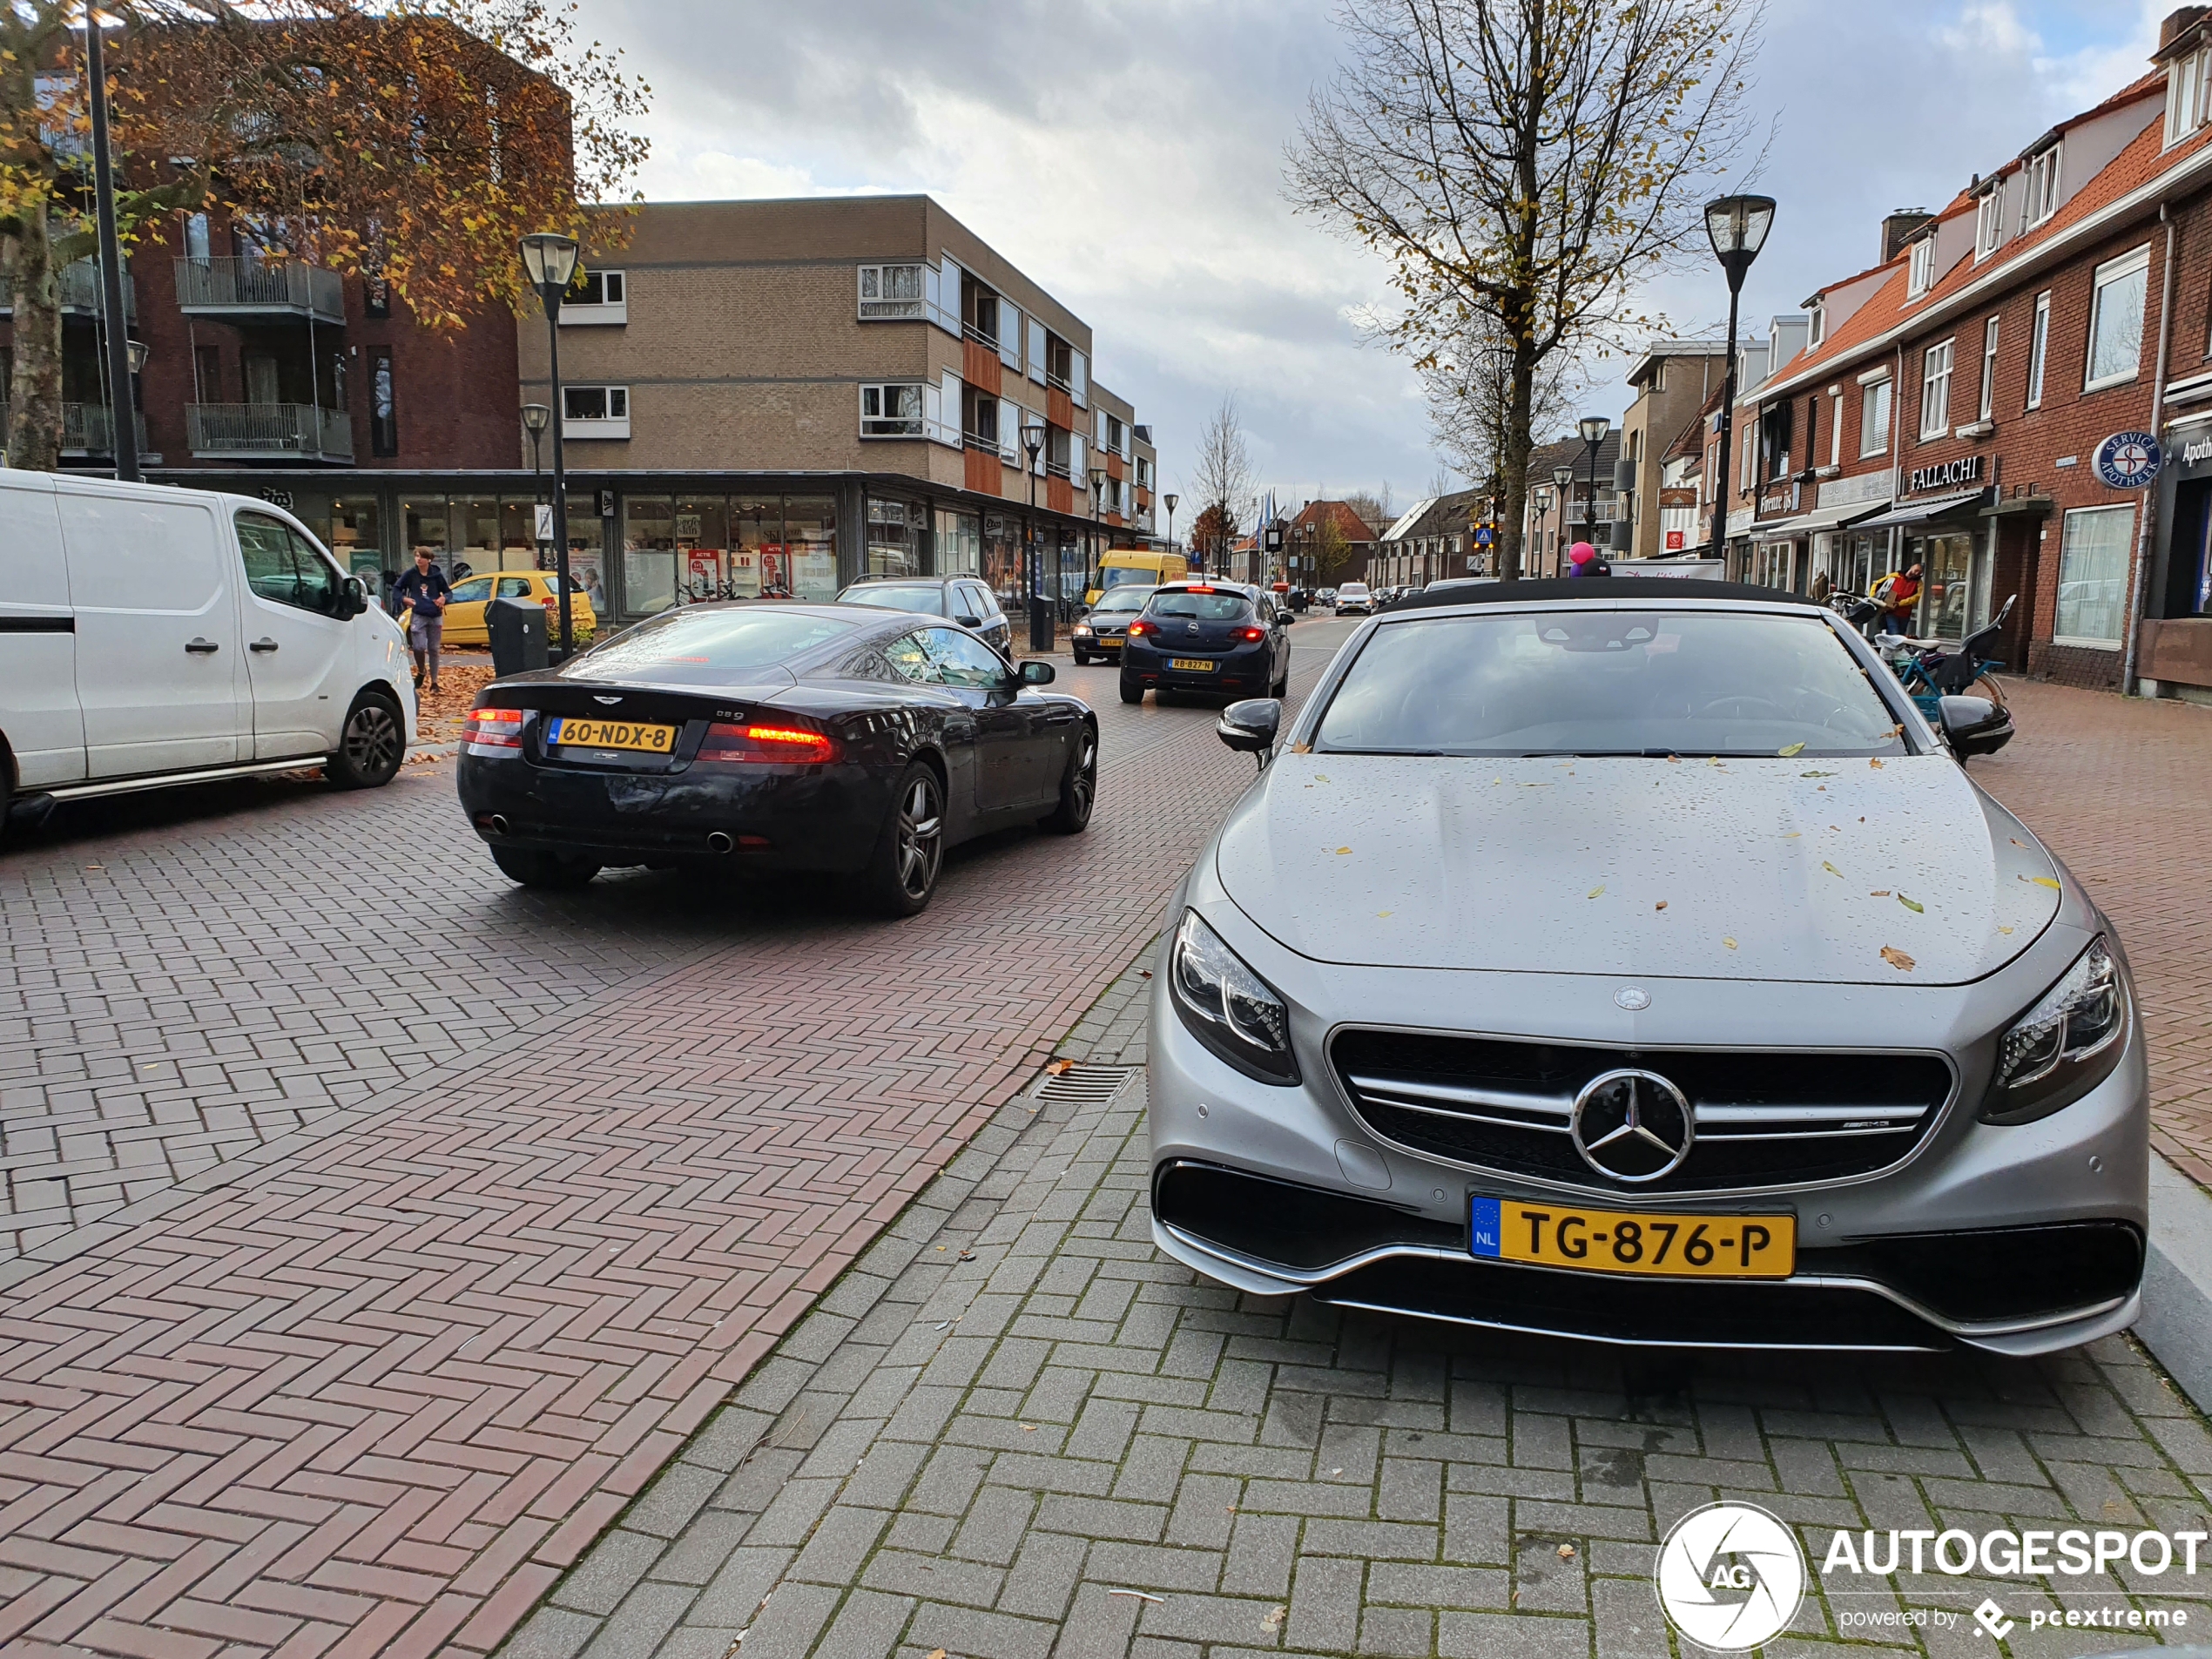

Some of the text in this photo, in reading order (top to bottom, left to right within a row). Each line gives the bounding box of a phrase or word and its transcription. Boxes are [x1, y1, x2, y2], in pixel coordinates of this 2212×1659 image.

[2106, 433, 2157, 453] SERVICE
[2182, 435, 2212, 468] Apoth
[1911, 455, 1978, 491] FALLACHI
[2101, 461, 2158, 487] APOTHEEK
[1760, 490, 1792, 514] Firenze ijs
[986, 518, 1001, 529] Etos
[1174, 659, 1211, 670] RB-827-N
[716, 710, 745, 721] DB9
[563, 723, 666, 748] 60-NDX-8
[1476, 1211, 1770, 1267] NL TG-876-P
